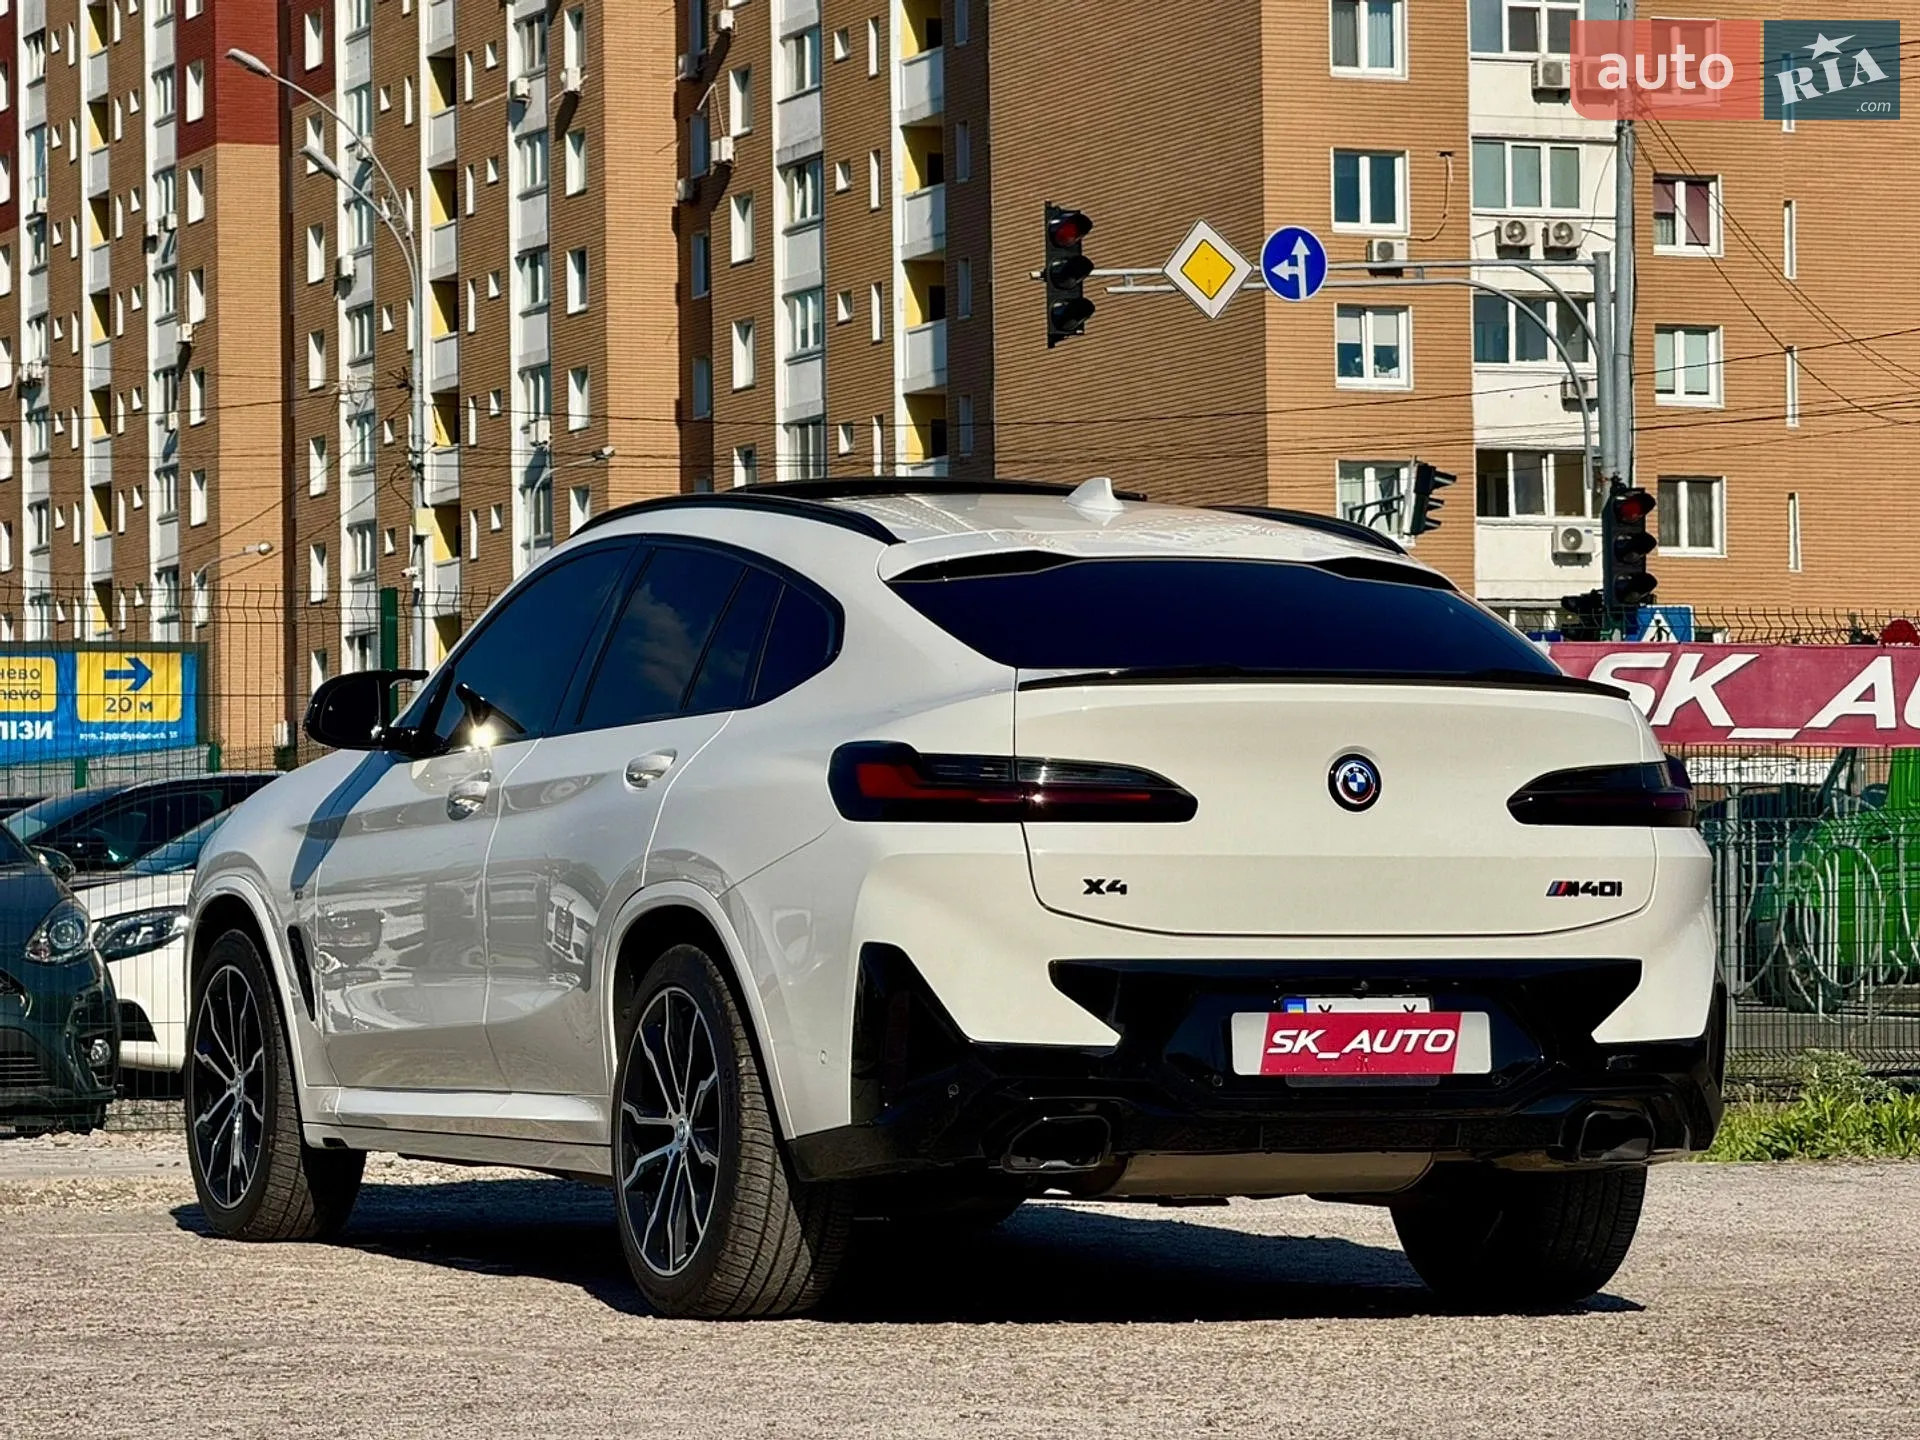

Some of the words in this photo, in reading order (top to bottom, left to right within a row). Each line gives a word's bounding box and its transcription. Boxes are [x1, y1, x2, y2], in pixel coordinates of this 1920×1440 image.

[105, 697, 132, 713] 20
[1588, 652, 1920, 740] SK_A
[1083, 879, 1127, 895] X4
[1267, 1029, 1456, 1059] SK_AUTO
